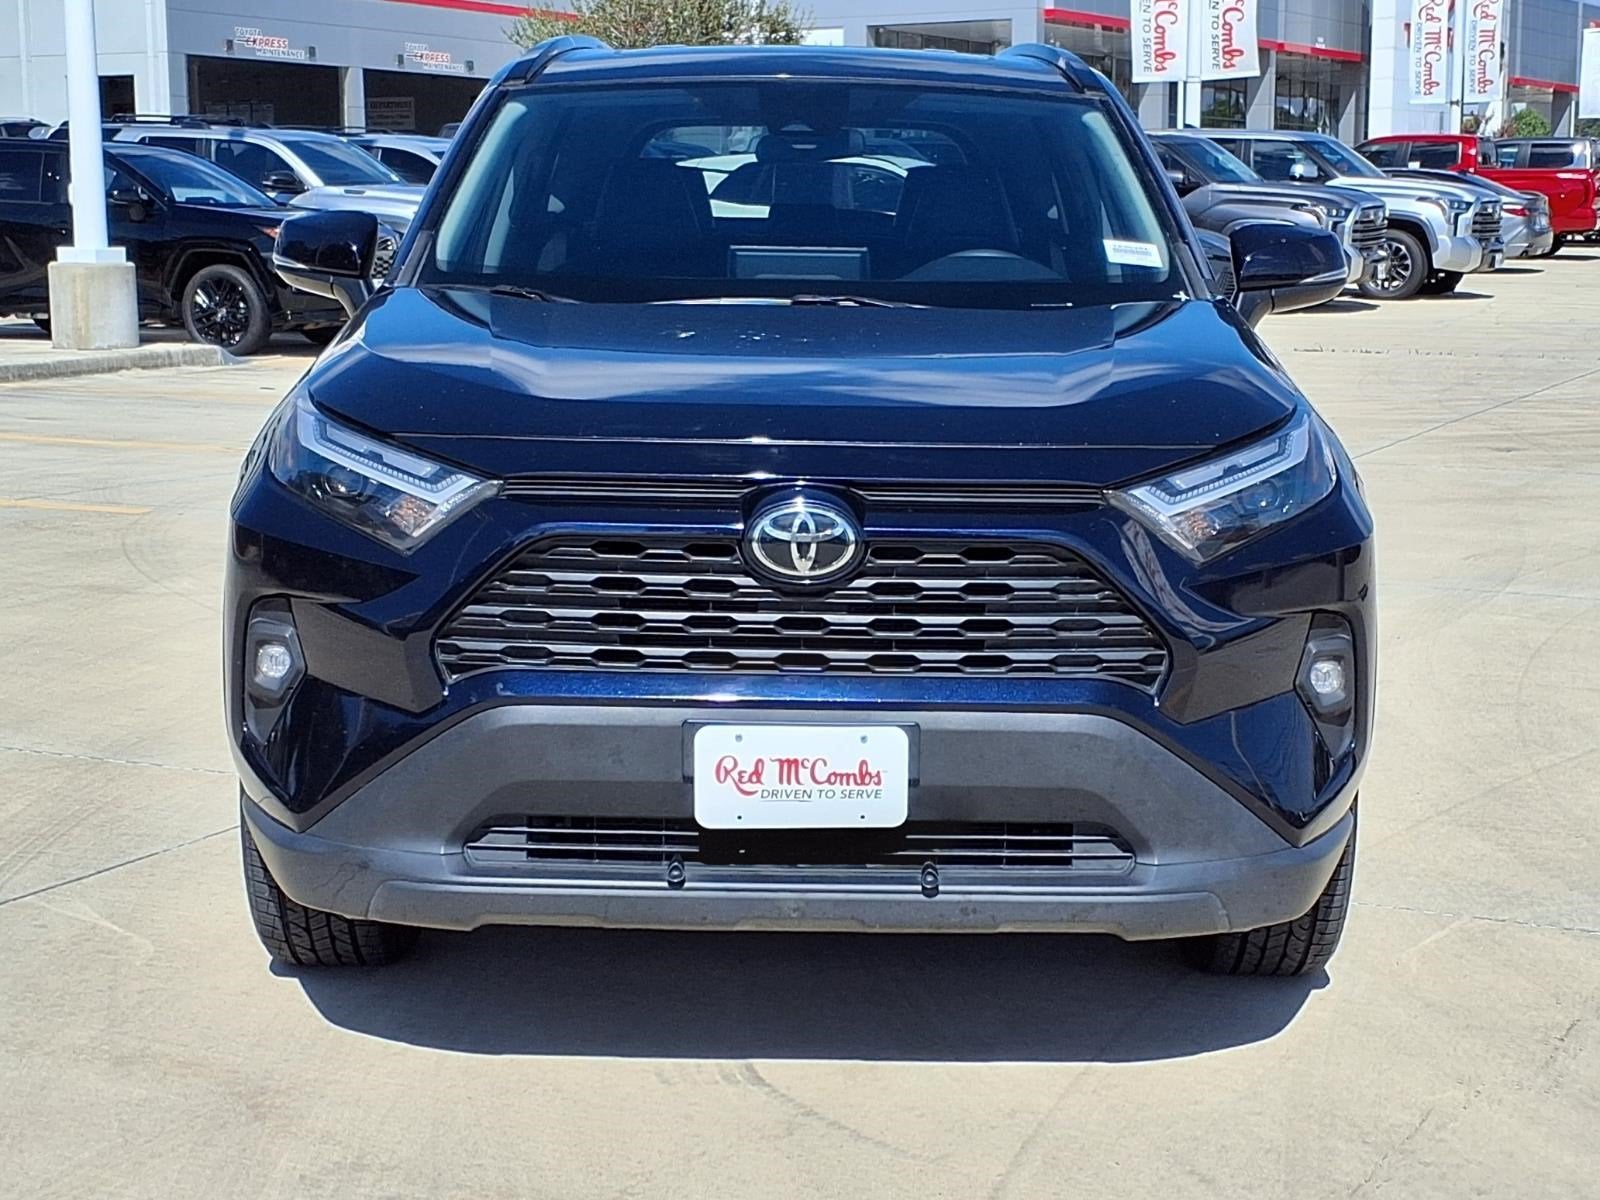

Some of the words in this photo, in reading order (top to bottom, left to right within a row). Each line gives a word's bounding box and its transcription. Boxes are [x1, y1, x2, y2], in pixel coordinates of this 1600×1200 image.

[1143, 18, 1151, 33] TO
[1211, 15, 1219, 30] TO
[235, 27, 262, 37] TOYOTA
[1221, 0, 1244, 69] cCombs
[245, 36, 288, 49] EXPRESS
[256, 48, 305, 59] MAINTENANCE
[414, 50, 450, 63] EXPRESS
[1142, 37, 1152, 72] SERVE
[1211, 34, 1220, 70] SERVE
[1478, 24, 1496, 94] McCombs
[1423, 26, 1441, 96] McCombs
[715, 755, 765, 796] Red
[769, 757, 882, 786] McCombs
[760, 788, 812, 800] DRIVEN
[816, 788, 836, 800] TO
[840, 788, 883, 800] SERVE
